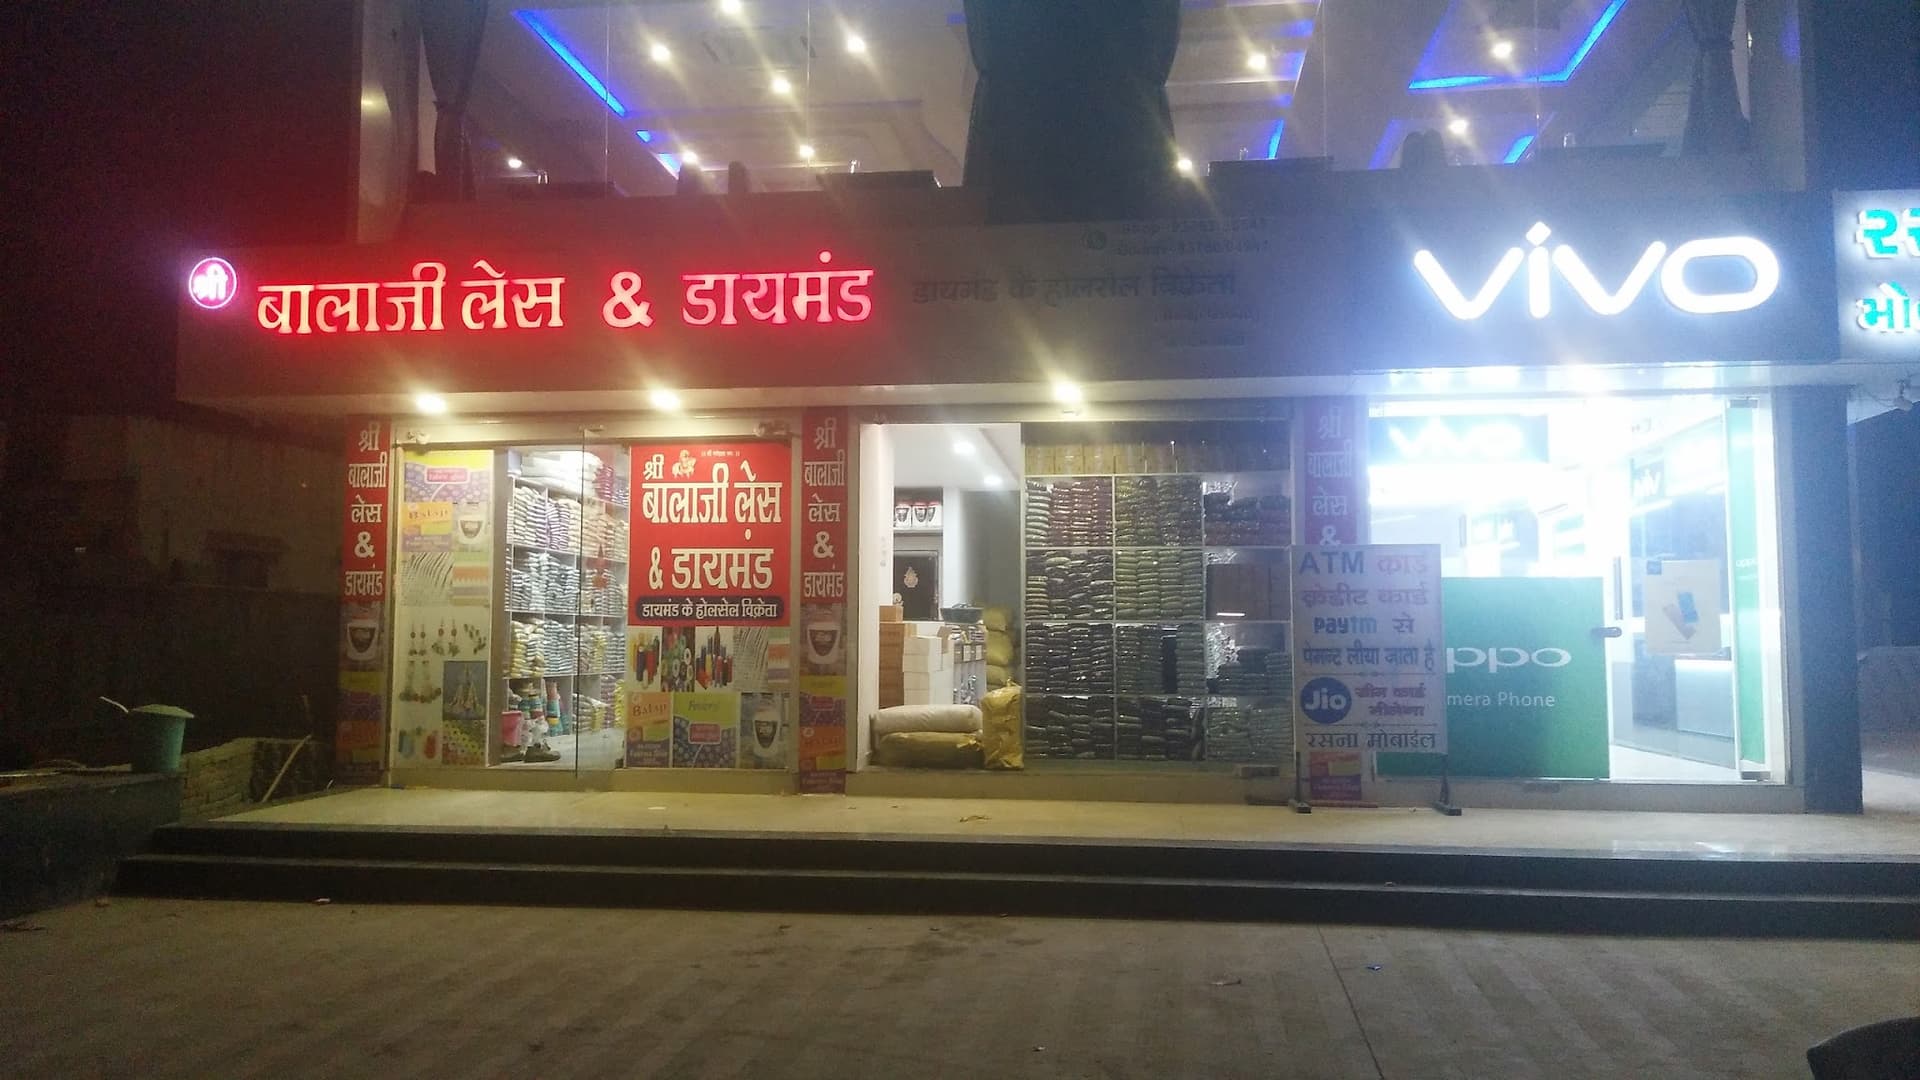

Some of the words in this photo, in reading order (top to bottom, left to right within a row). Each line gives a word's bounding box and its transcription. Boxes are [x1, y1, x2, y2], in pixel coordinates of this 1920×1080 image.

[1413, 221, 1779, 320] vivo
[257, 262, 446, 334] बालाजी
[461, 259, 566, 330] लेस
[602, 271, 653, 328] &
[682, 250, 874, 326] डायमंड
[1855, 281, 1920, 335] મો
[358, 422, 381, 452] श्री
[814, 417, 837, 450] श्री
[1317, 405, 1343, 440] श्री
[348, 451, 388, 488] बालाजी
[643, 453, 665, 481] श्री
[804, 449, 846, 487] बालाजी
[1306, 439, 1353, 478] बालाजी
[642, 463, 730, 524] बालाजी
[734, 460, 783, 524] लेस
[1312, 486, 1349, 516] लेस
[351, 494, 383, 523] लेस
[808, 493, 841, 522] लेस
[354, 531, 376, 558] &
[813, 531, 835, 559] &
[1320, 524, 1342, 546] &
[648, 547, 664, 590] &
[671, 529, 775, 590] डायमंड
[1299, 551, 1364, 575] ATM
[345, 564, 384, 597] डायमंड
[803, 564, 844, 598] डायमंड
[1376, 581, 1429, 606] कार्ड
[641, 598, 680, 617] डायमंड
[681, 597, 694, 617] के
[696, 597, 739, 619] होलसेल
[741, 597, 777, 618] विक्रेता
[1392, 611, 1416, 633] से
[1346, 639, 1380, 665] लीया
[1384, 647, 1419, 665] जाता
[1423, 639, 1437, 672] है
[1446, 647, 1572, 673] ppo
[1305, 687, 1347, 711] Jio
[1498, 691, 1556, 707] Phone
[1306, 731, 1359, 748] रसना
